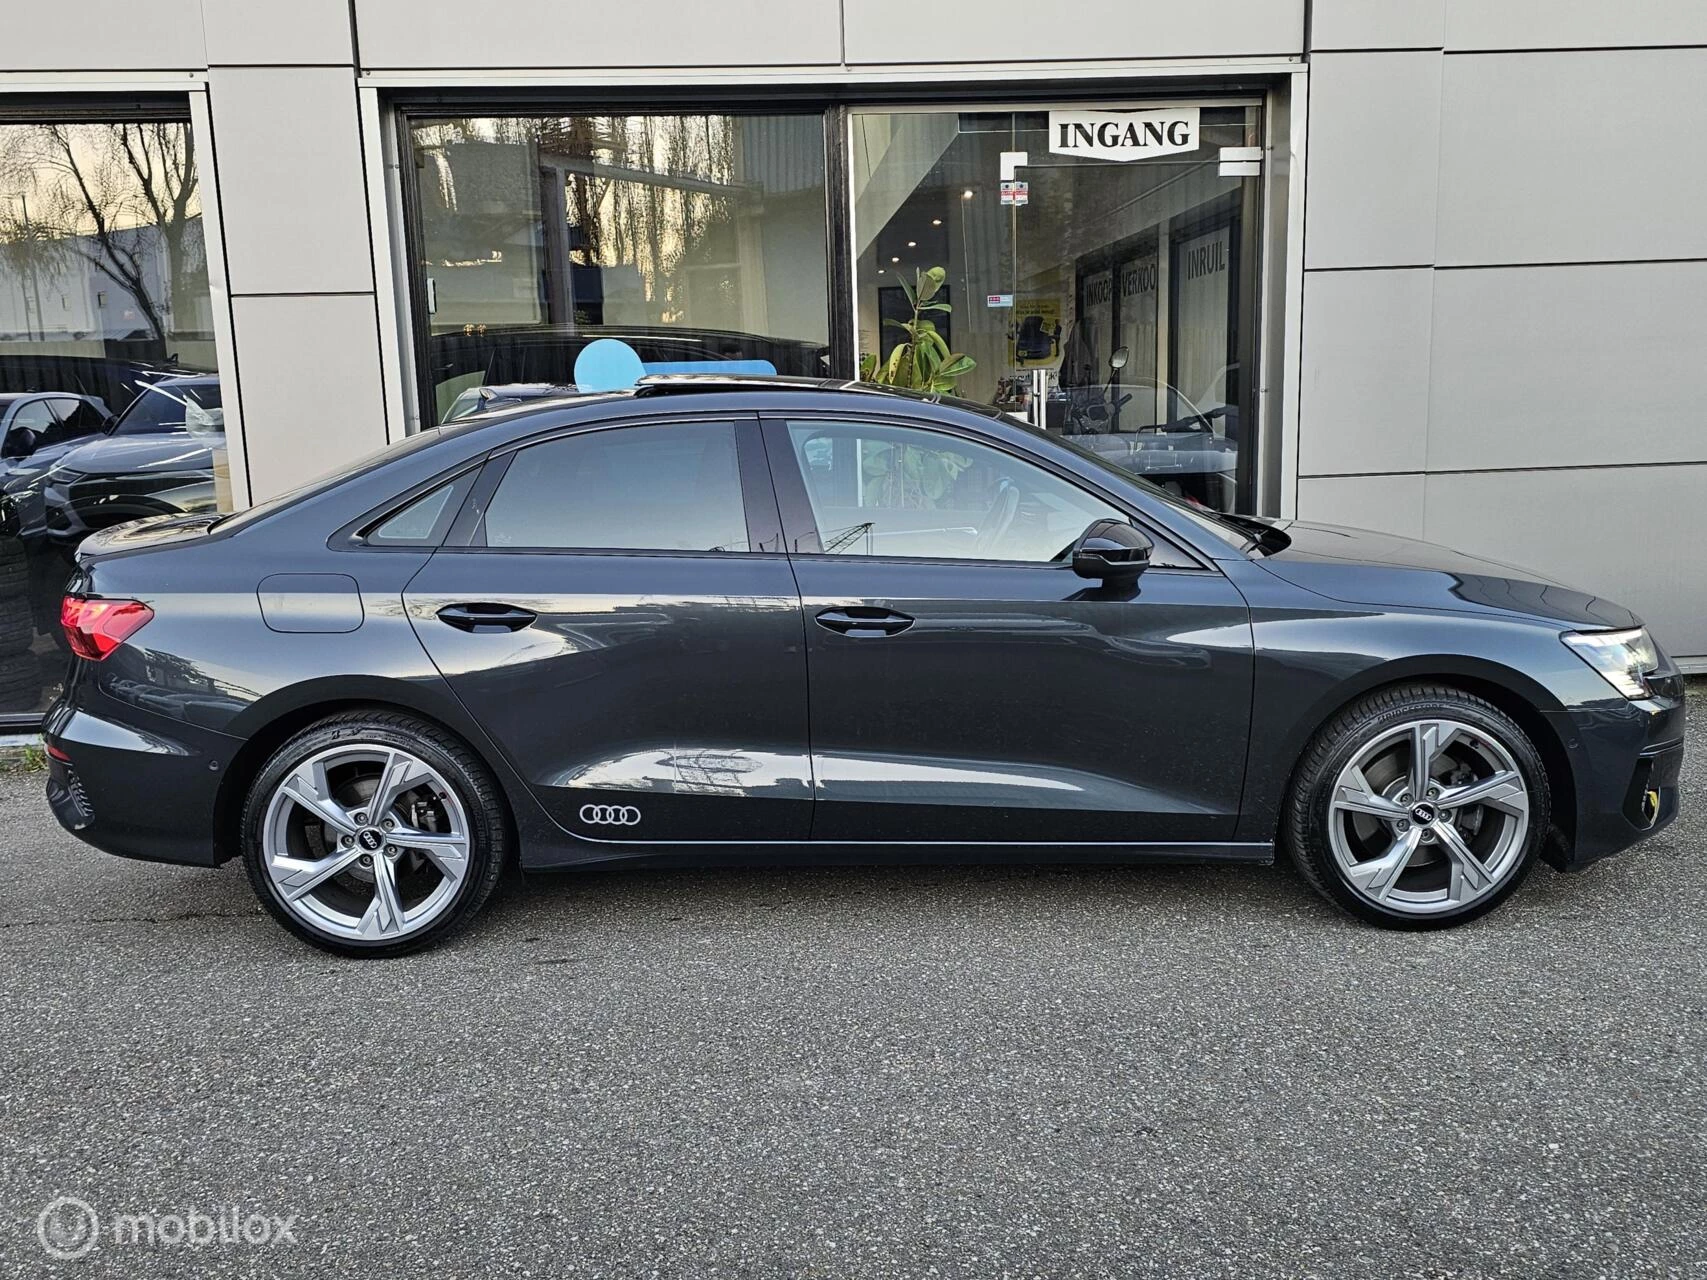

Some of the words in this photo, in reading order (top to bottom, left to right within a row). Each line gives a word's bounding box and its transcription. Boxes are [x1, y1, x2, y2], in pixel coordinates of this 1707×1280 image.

[1058, 121, 1191, 148] INGANG
[1188, 241, 1225, 280] INRUIL
[1122, 264, 1156, 297] VERKOO
